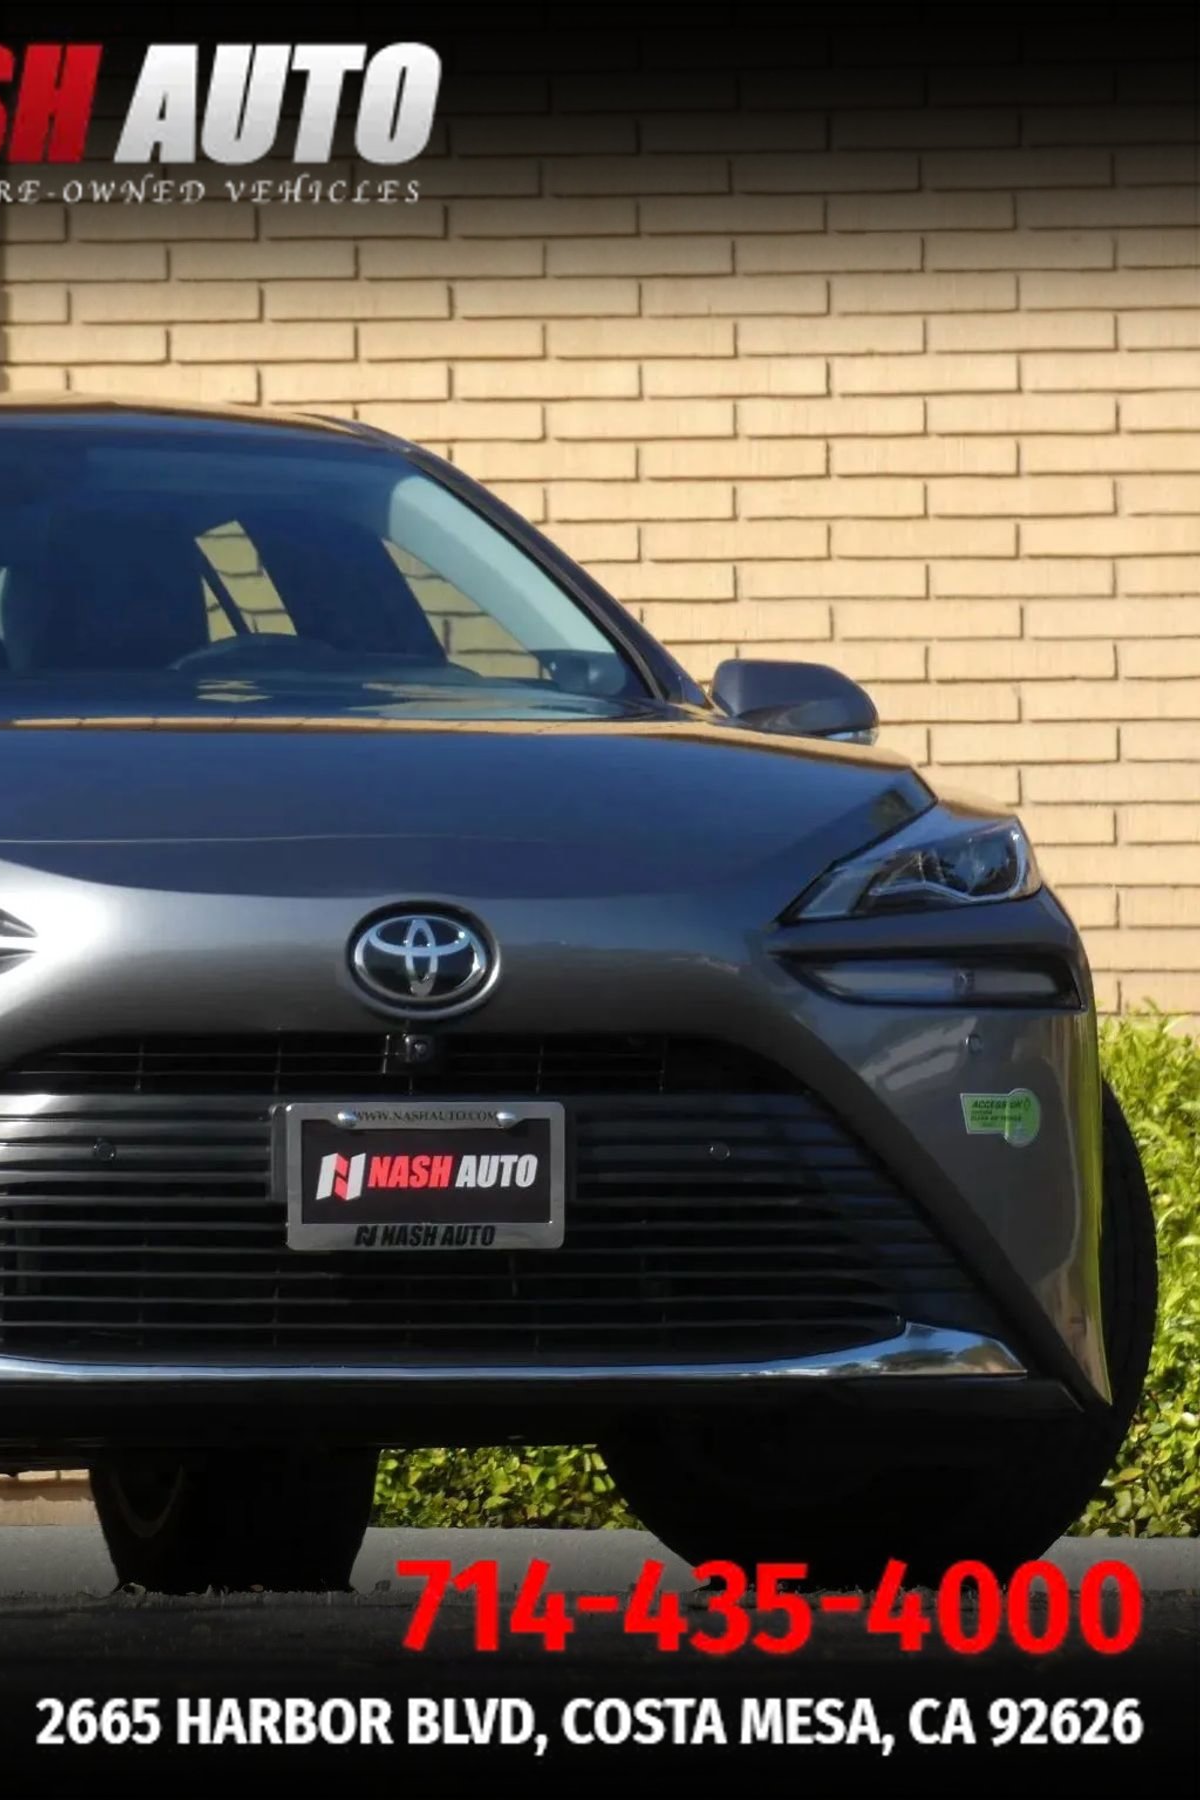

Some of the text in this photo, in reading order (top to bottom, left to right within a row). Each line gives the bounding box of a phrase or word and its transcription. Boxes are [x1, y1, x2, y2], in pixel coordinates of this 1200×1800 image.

[353, 1109, 498, 1122] WWW.NASHAUTO.COM
[367, 1155, 454, 1188] NASH
[455, 1154, 538, 1188] AUTO
[380, 1225, 438, 1247] NASH
[440, 1225, 496, 1247] AUTO
